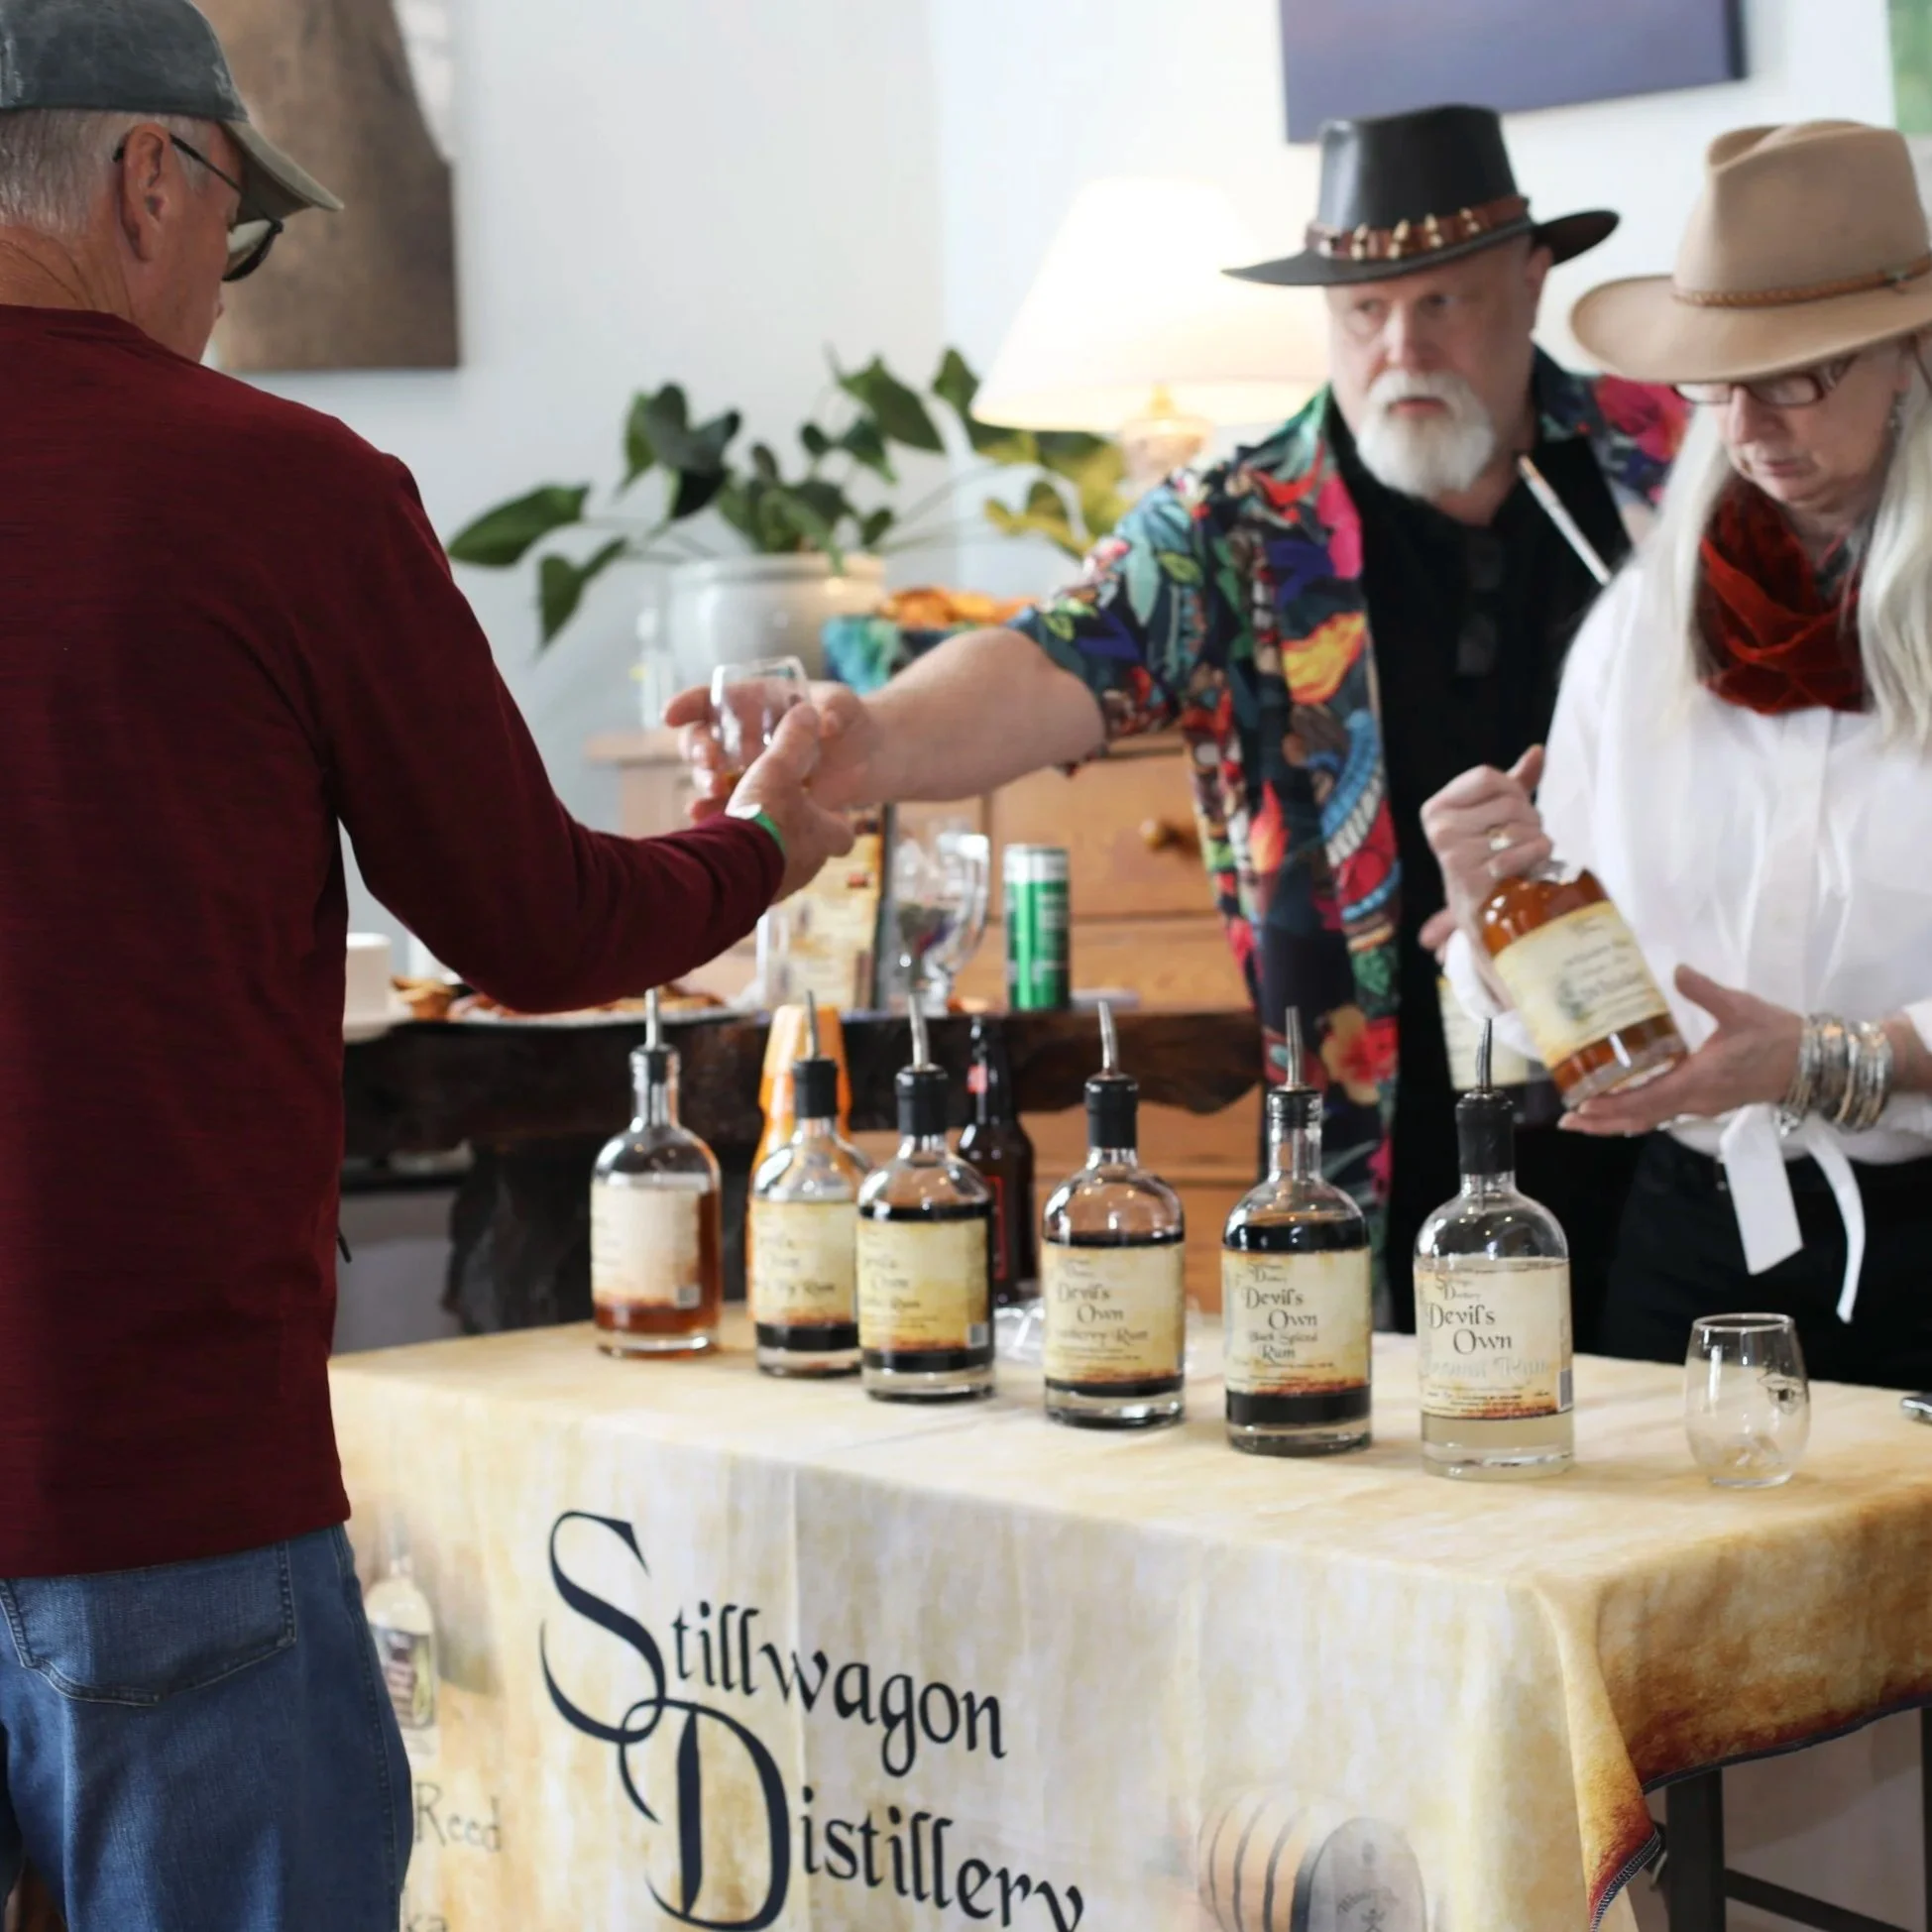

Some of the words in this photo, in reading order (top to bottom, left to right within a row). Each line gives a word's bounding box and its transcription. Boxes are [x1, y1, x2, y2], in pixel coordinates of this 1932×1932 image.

[1241, 1286, 1305, 1309] Devil's
[1077, 1303, 1124, 1323] Own
[1268, 1308, 1318, 1330] Own
[1426, 1302, 1496, 1329] Devil's
[1453, 1328, 1513, 1355] Own
[1257, 1343, 1296, 1366] Rum
[540, 1510, 1008, 1777] Stillwagon
[618, 1697, 1084, 1932] Distillery
